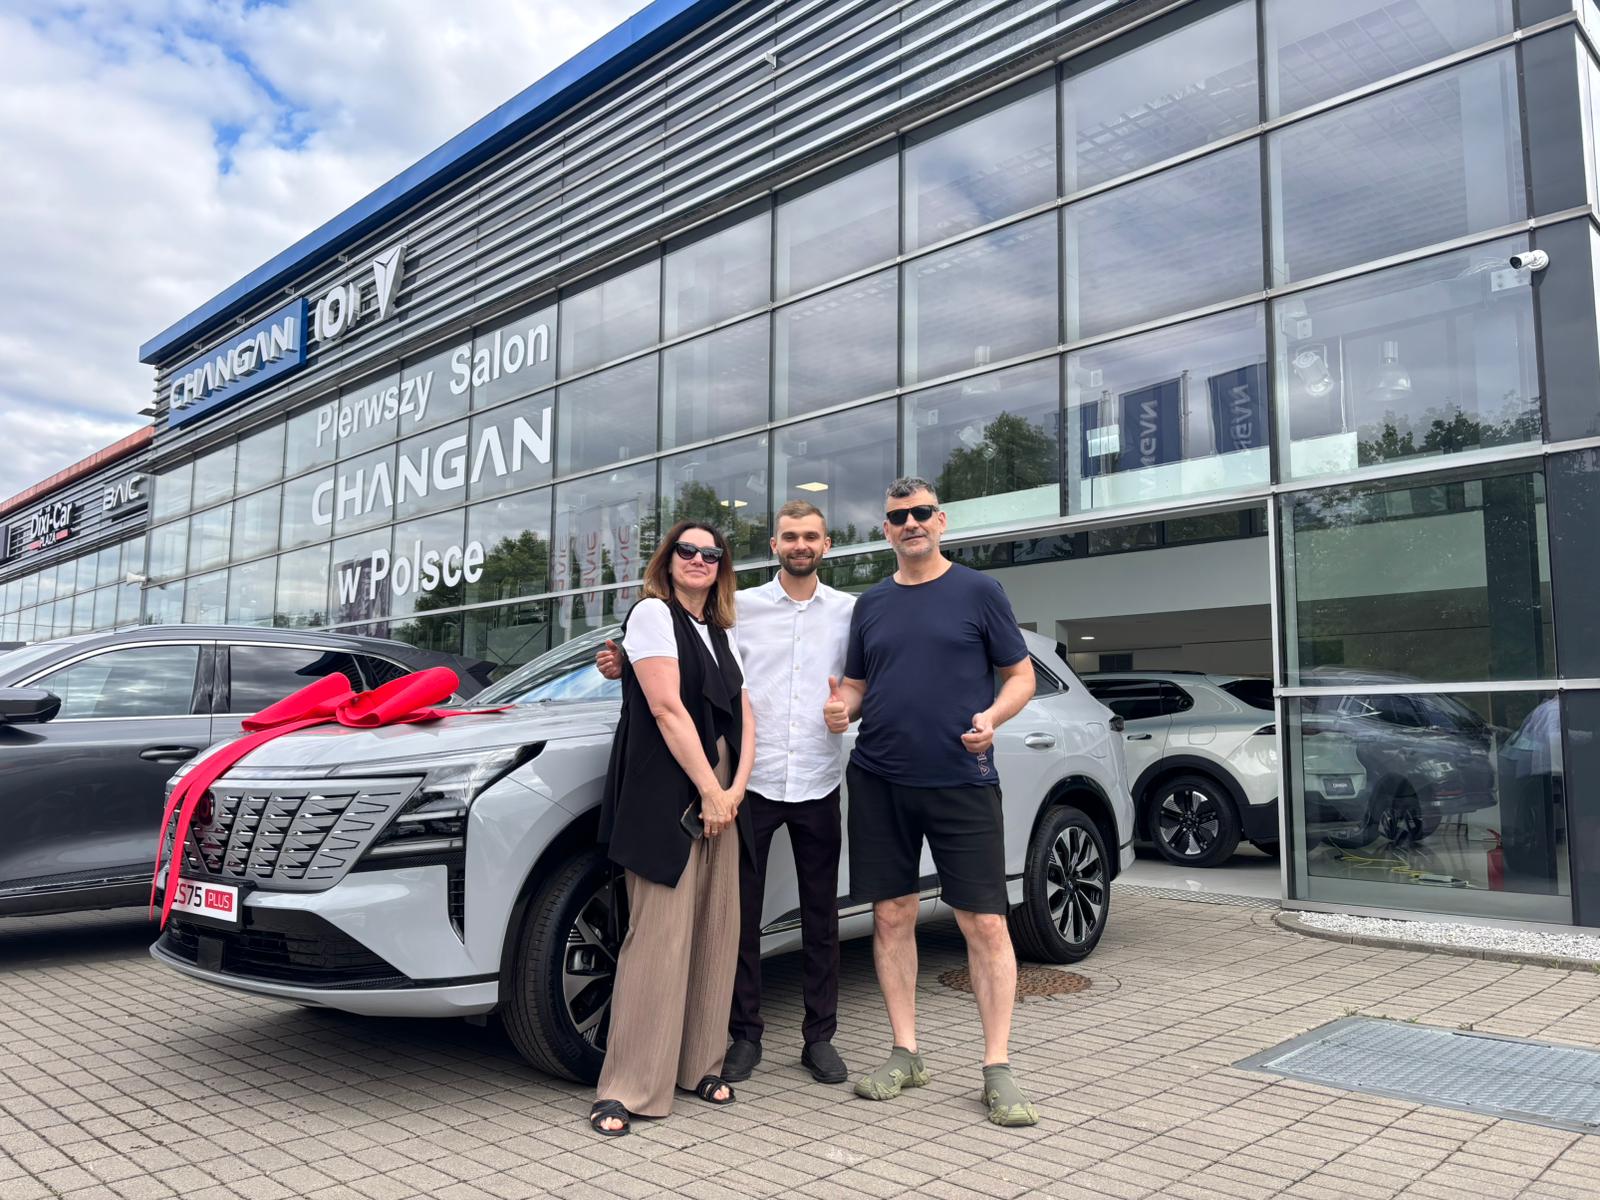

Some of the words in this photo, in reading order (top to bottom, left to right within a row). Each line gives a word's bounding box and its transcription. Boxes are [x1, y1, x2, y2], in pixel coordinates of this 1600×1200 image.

[170, 316, 297, 409] CHANGAN
[316, 370, 434, 448] Pierwszy
[449, 323, 549, 395] Salon
[312, 407, 552, 526] CHANGAN
[103, 475, 144, 511] BAIC
[30, 502, 73, 539] Dixi-Car
[40, 532, 56, 548] PLAZA
[338, 566, 362, 605] w
[369, 540, 485, 600] Polsce
[207, 892, 230, 909] PLUS
